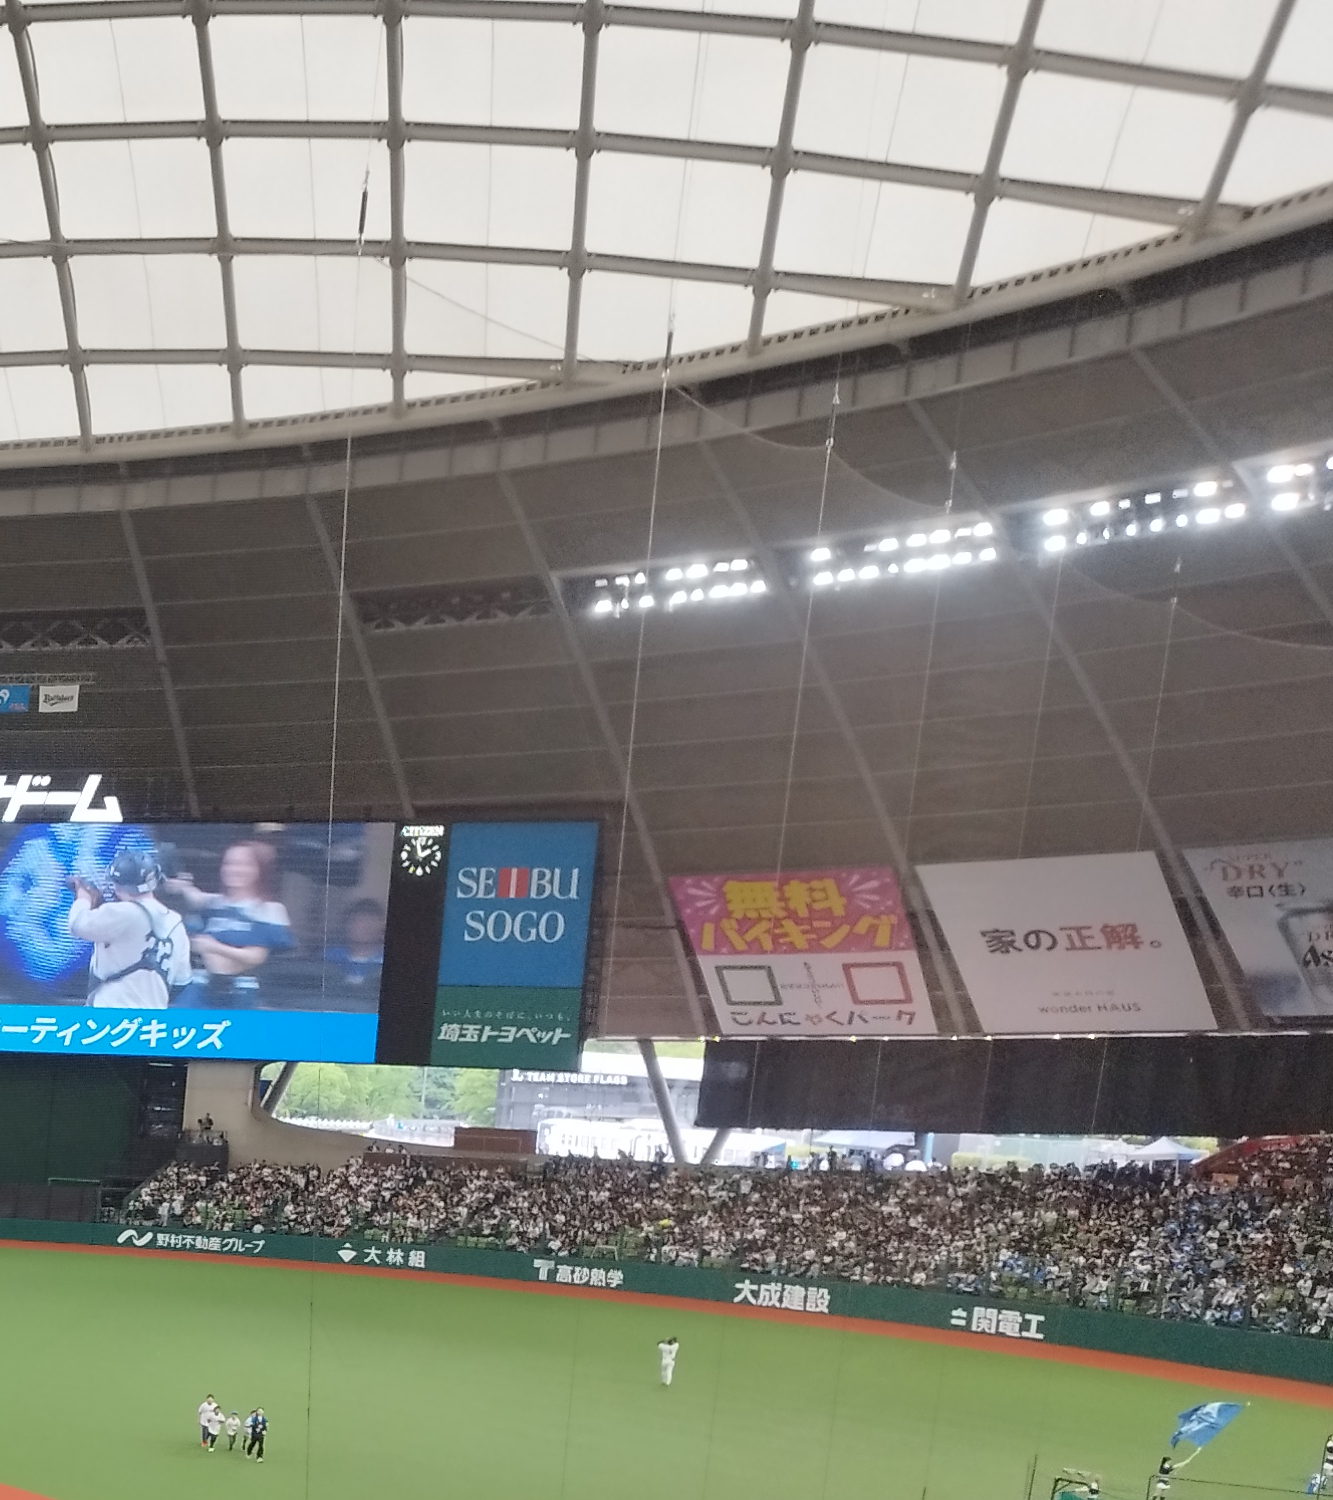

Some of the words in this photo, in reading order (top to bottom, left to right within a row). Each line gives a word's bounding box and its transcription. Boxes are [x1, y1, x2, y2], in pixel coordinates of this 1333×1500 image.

[456, 867, 580, 899] SEIBU
[723, 878, 847, 919] 無料
[464, 910, 565, 943] SOGO
[701, 914, 898, 951] バイキング
[980, 923, 1162, 954] 家の正解。
[437, 1022, 571, 1045] 埼玉トヨペット
[526, 1073, 555, 1083] TEAM
[594, 1075, 628, 1086] FLAGS
[156, 1233, 265, 1254] 野村不動産グループ
[363, 1246, 426, 1268] 大林組
[734, 1278, 831, 1313] 大成建設
[972, 1306, 1045, 1339] 関電工
